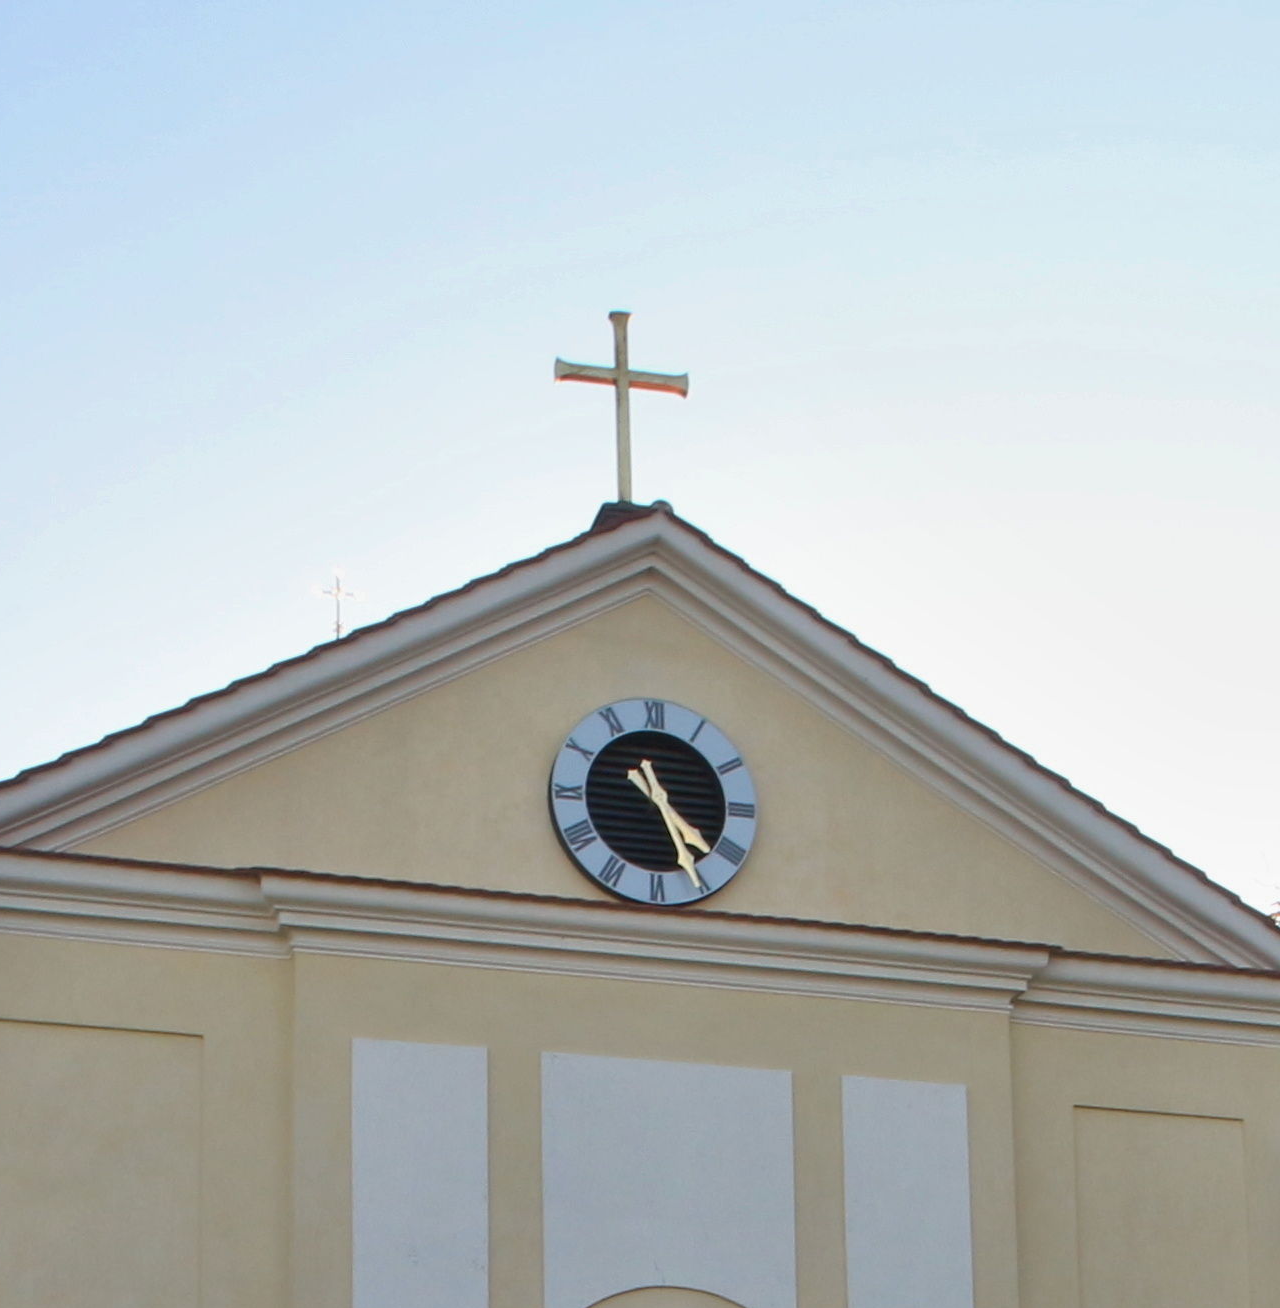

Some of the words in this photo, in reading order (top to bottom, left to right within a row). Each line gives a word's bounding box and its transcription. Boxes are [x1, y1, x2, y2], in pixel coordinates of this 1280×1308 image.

[599, 707, 624, 736] XI
[644, 701, 665, 730] XII
[690, 719, 706, 742] I
[565, 737, 594, 761] X
[717, 757, 742, 775] II
[554, 783, 583, 799] IX
[728, 802, 755, 819] III
[564, 819, 597, 852] VIII
[599, 855, 625, 888] VII
[650, 873, 665, 902] VI
